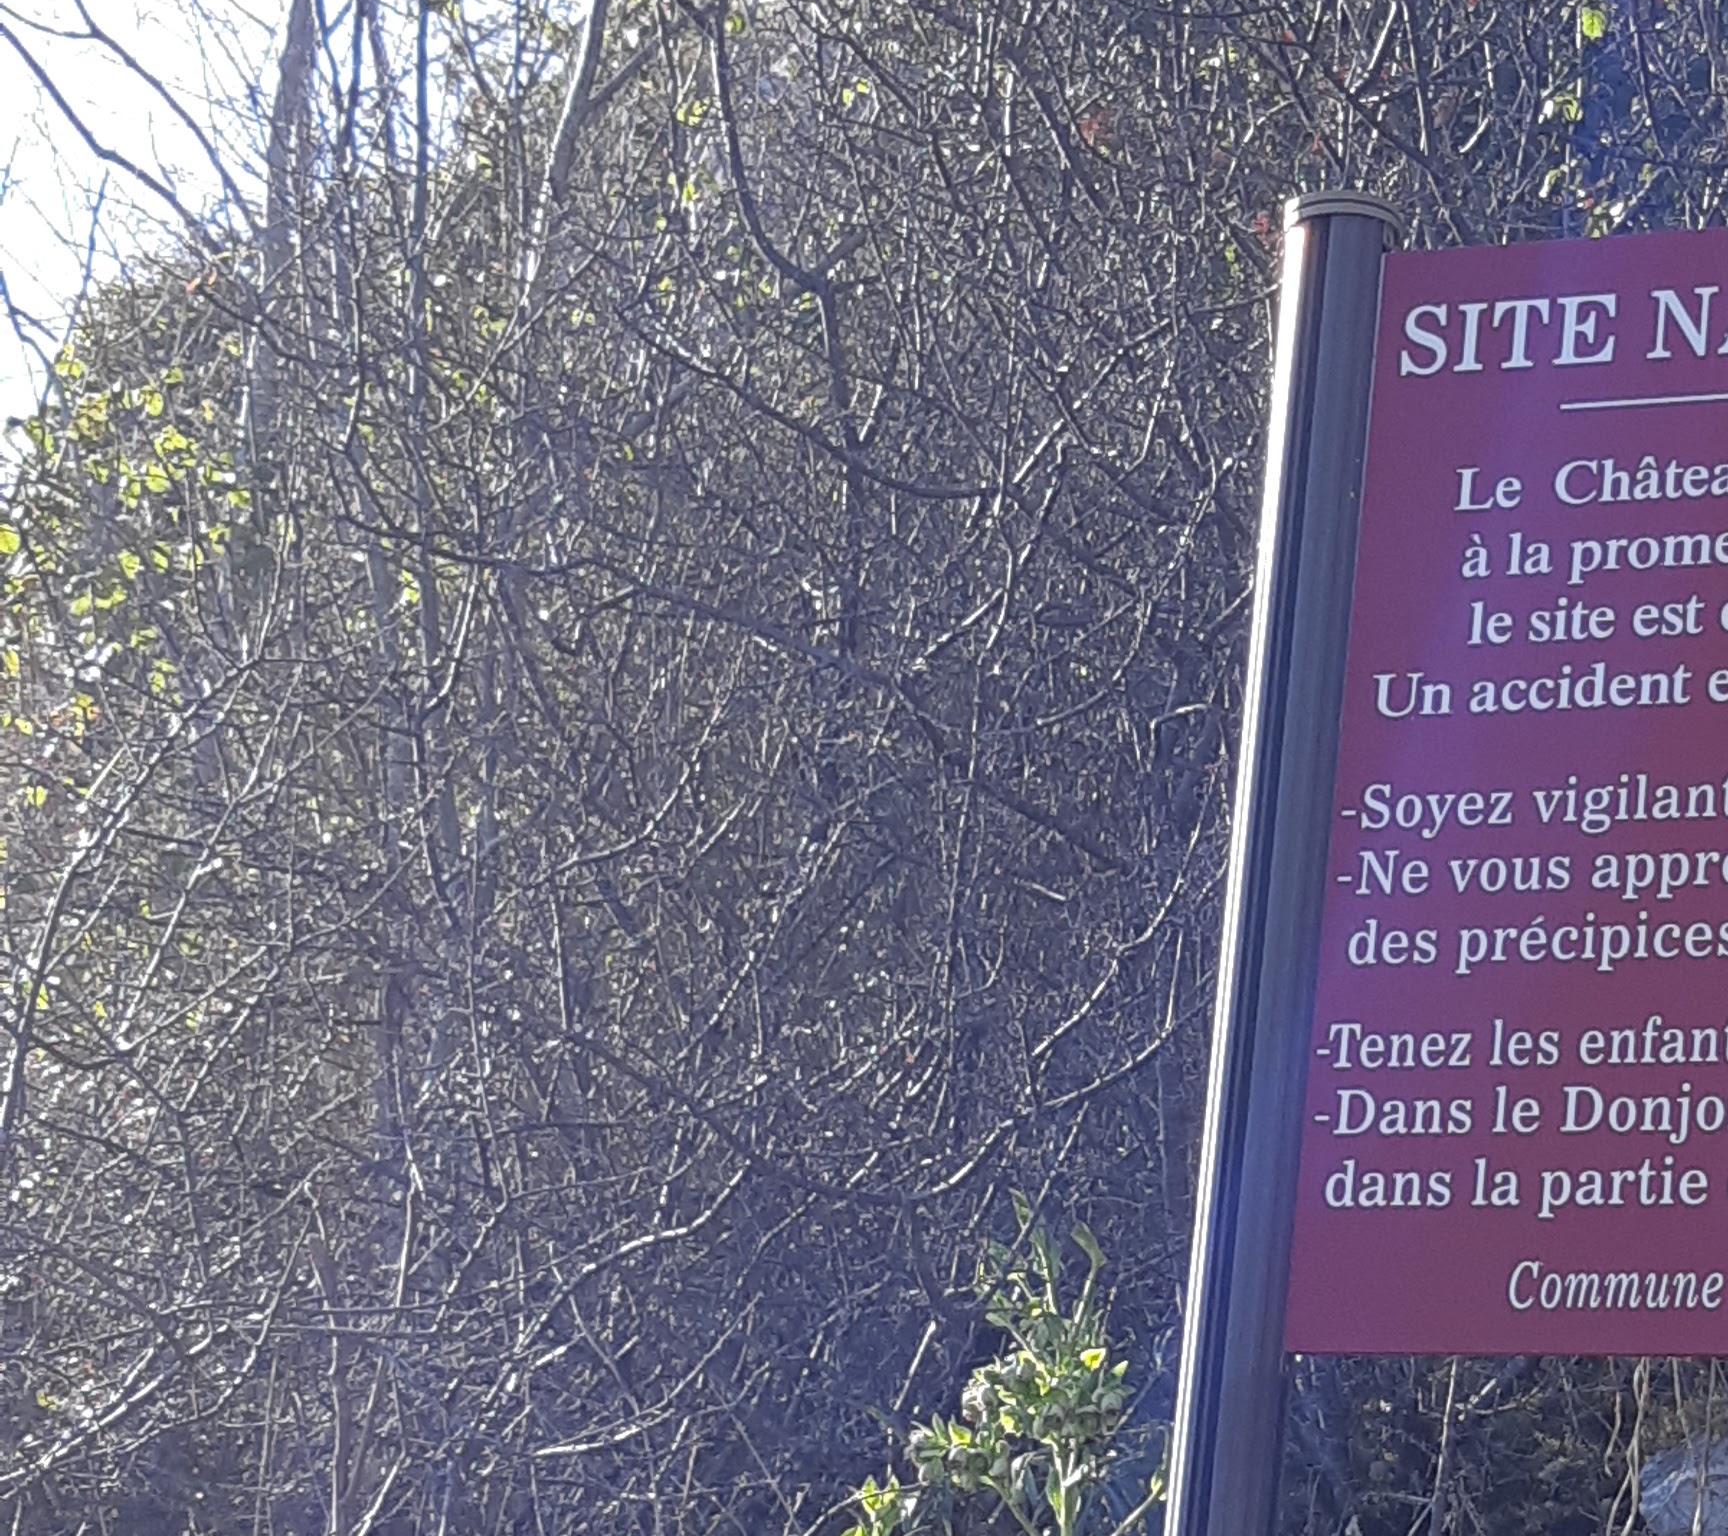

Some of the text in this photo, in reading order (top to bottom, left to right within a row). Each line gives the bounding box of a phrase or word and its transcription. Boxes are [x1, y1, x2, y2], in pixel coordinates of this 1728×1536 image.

[1399, 292, 1618, 378] SITE
[1452, 466, 1523, 512] Le
[1460, 532, 1492, 579] à
[1504, 531, 1554, 576] la
[1465, 600, 1514, 646] le
[1527, 595, 1617, 644] site
[1631, 593, 1706, 638] est
[1371, 671, 1452, 719] Un
[1468, 660, 1694, 714] accident
[1448, 855, 1572, 894] vous
[1347, 917, 1438, 967] des
[1488, 1017, 1561, 1067] les
[1490, 1084, 1541, 1134] le
[1324, 1158, 1453, 1209] dans
[1470, 1156, 1521, 1207] la
[1536, 1154, 1709, 1220] partie
[1508, 1259, 1725, 1311] Commune
